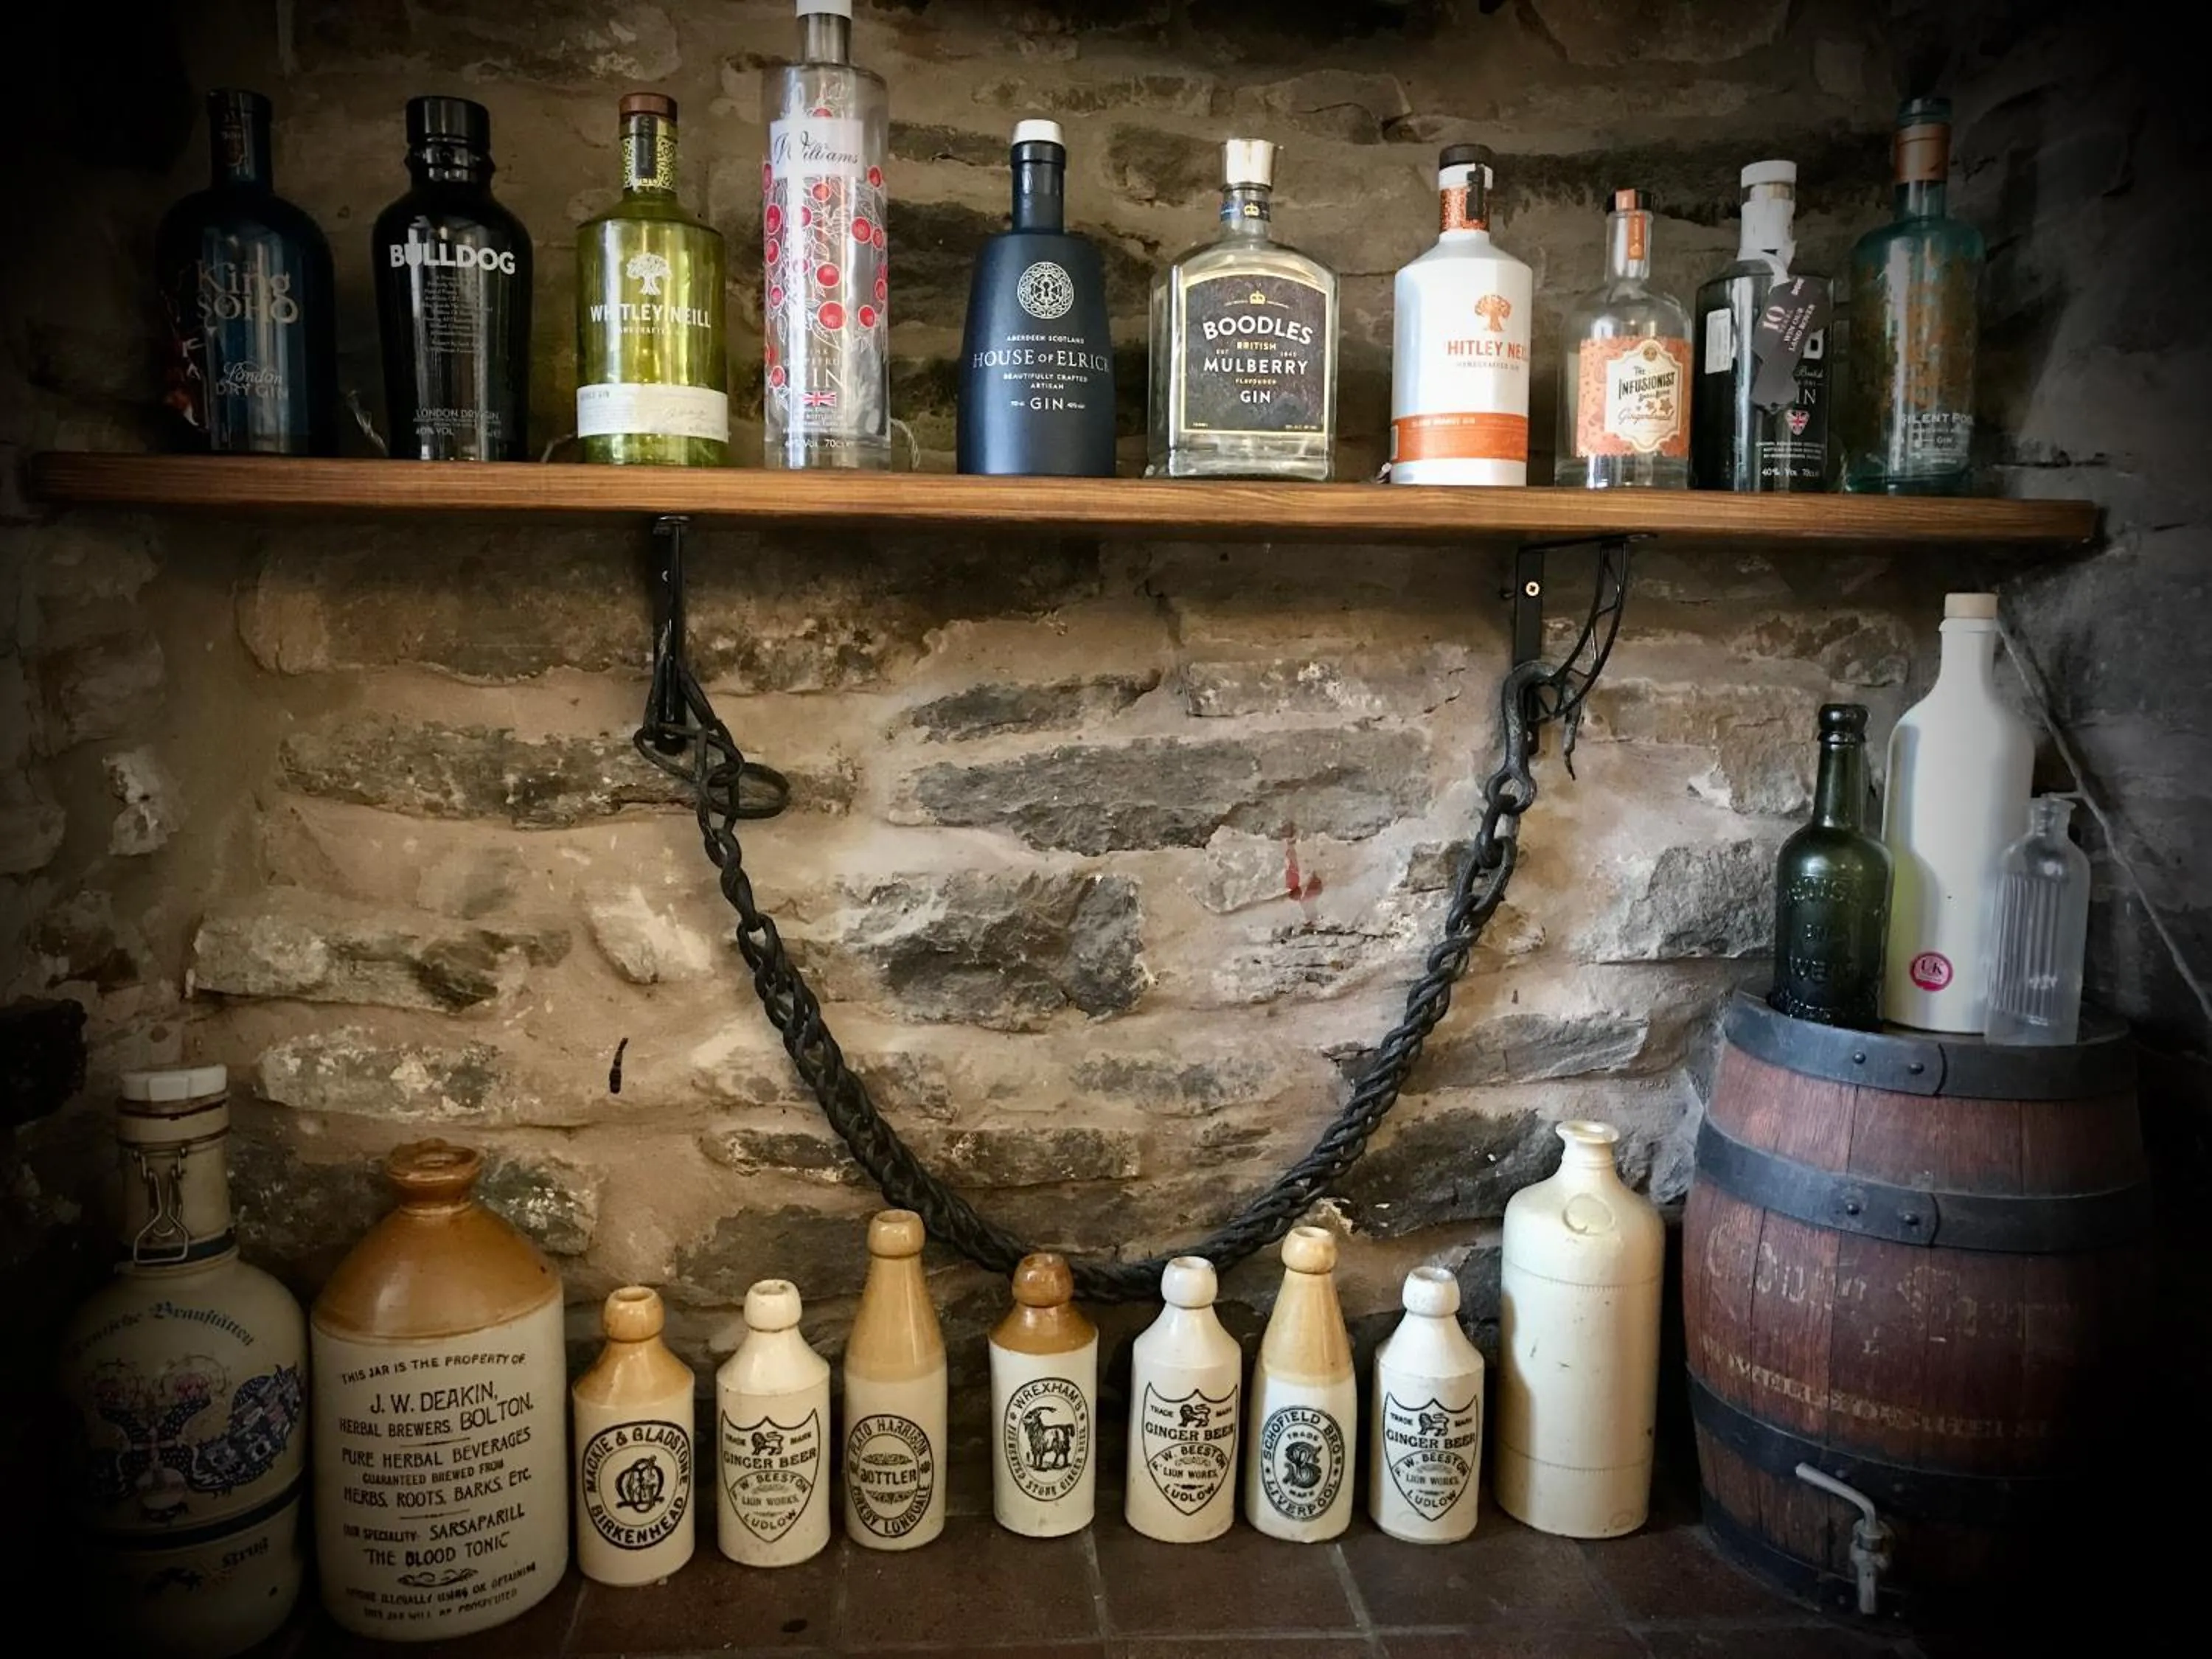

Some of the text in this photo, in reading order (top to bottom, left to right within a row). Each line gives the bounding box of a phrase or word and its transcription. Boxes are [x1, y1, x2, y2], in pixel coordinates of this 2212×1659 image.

[389, 241, 517, 276] BULLDOG
[590, 303, 664, 323] WHTLEY
[1202, 315, 1314, 345] BOODLES
[1236, 341, 1277, 352] BRITISH
[972, 348, 1035, 369] HOUSE
[1037, 352, 1054, 364] OF
[1203, 356, 1309, 376] MULBERRY
[1003, 372, 1054, 381] BEAUTIFULLY
[1029, 382, 1065, 391] ARTISAN
[1618, 371, 1675, 400] INFUSIONIST
[1029, 396, 1065, 411] GIN
[1239, 389, 1272, 404] GIN
[341, 1352, 527, 1385] THIS JAR IS THE PROPERTY OF
[369, 1393, 386, 1415] J.
[389, 1393, 414, 1413] W.
[1150, 1404, 1175, 1418] TRADE
[338, 1417, 383, 1439] HERBAL
[1390, 1411, 1413, 1426] TRADE
[876, 1417, 929, 1458] HARRISON
[1144, 1421, 1200, 1441] GINGER
[1263, 1411, 1321, 1461] SCHOFIELD
[1287, 1431, 1319, 1442] TRADE
[1385, 1429, 1475, 1450] GINGER BEER
[341, 1425, 532, 1470] PURE HERBAL BEVERAGES
[723, 1446, 817, 1470] GINGER BEER
[1180, 1444, 1226, 1470] BEESTON
[585, 1426, 689, 1494] MACKIE & GLADSTONE
[361, 1458, 505, 1486] GUARANTEED BREWED FROM
[860, 1467, 918, 1486] BOTTLER
[1163, 1482, 1216, 1502] LUDLOW
[1266, 1479, 1338, 1517] LIVERPOOL
[1407, 1489, 1457, 1508] LUDLOW
[591, 1495, 684, 1545] BIRKENHEAD
[742, 1509, 797, 1531] LUDLOW
[363, 1531, 512, 1568] THE BLOOD TONIC
